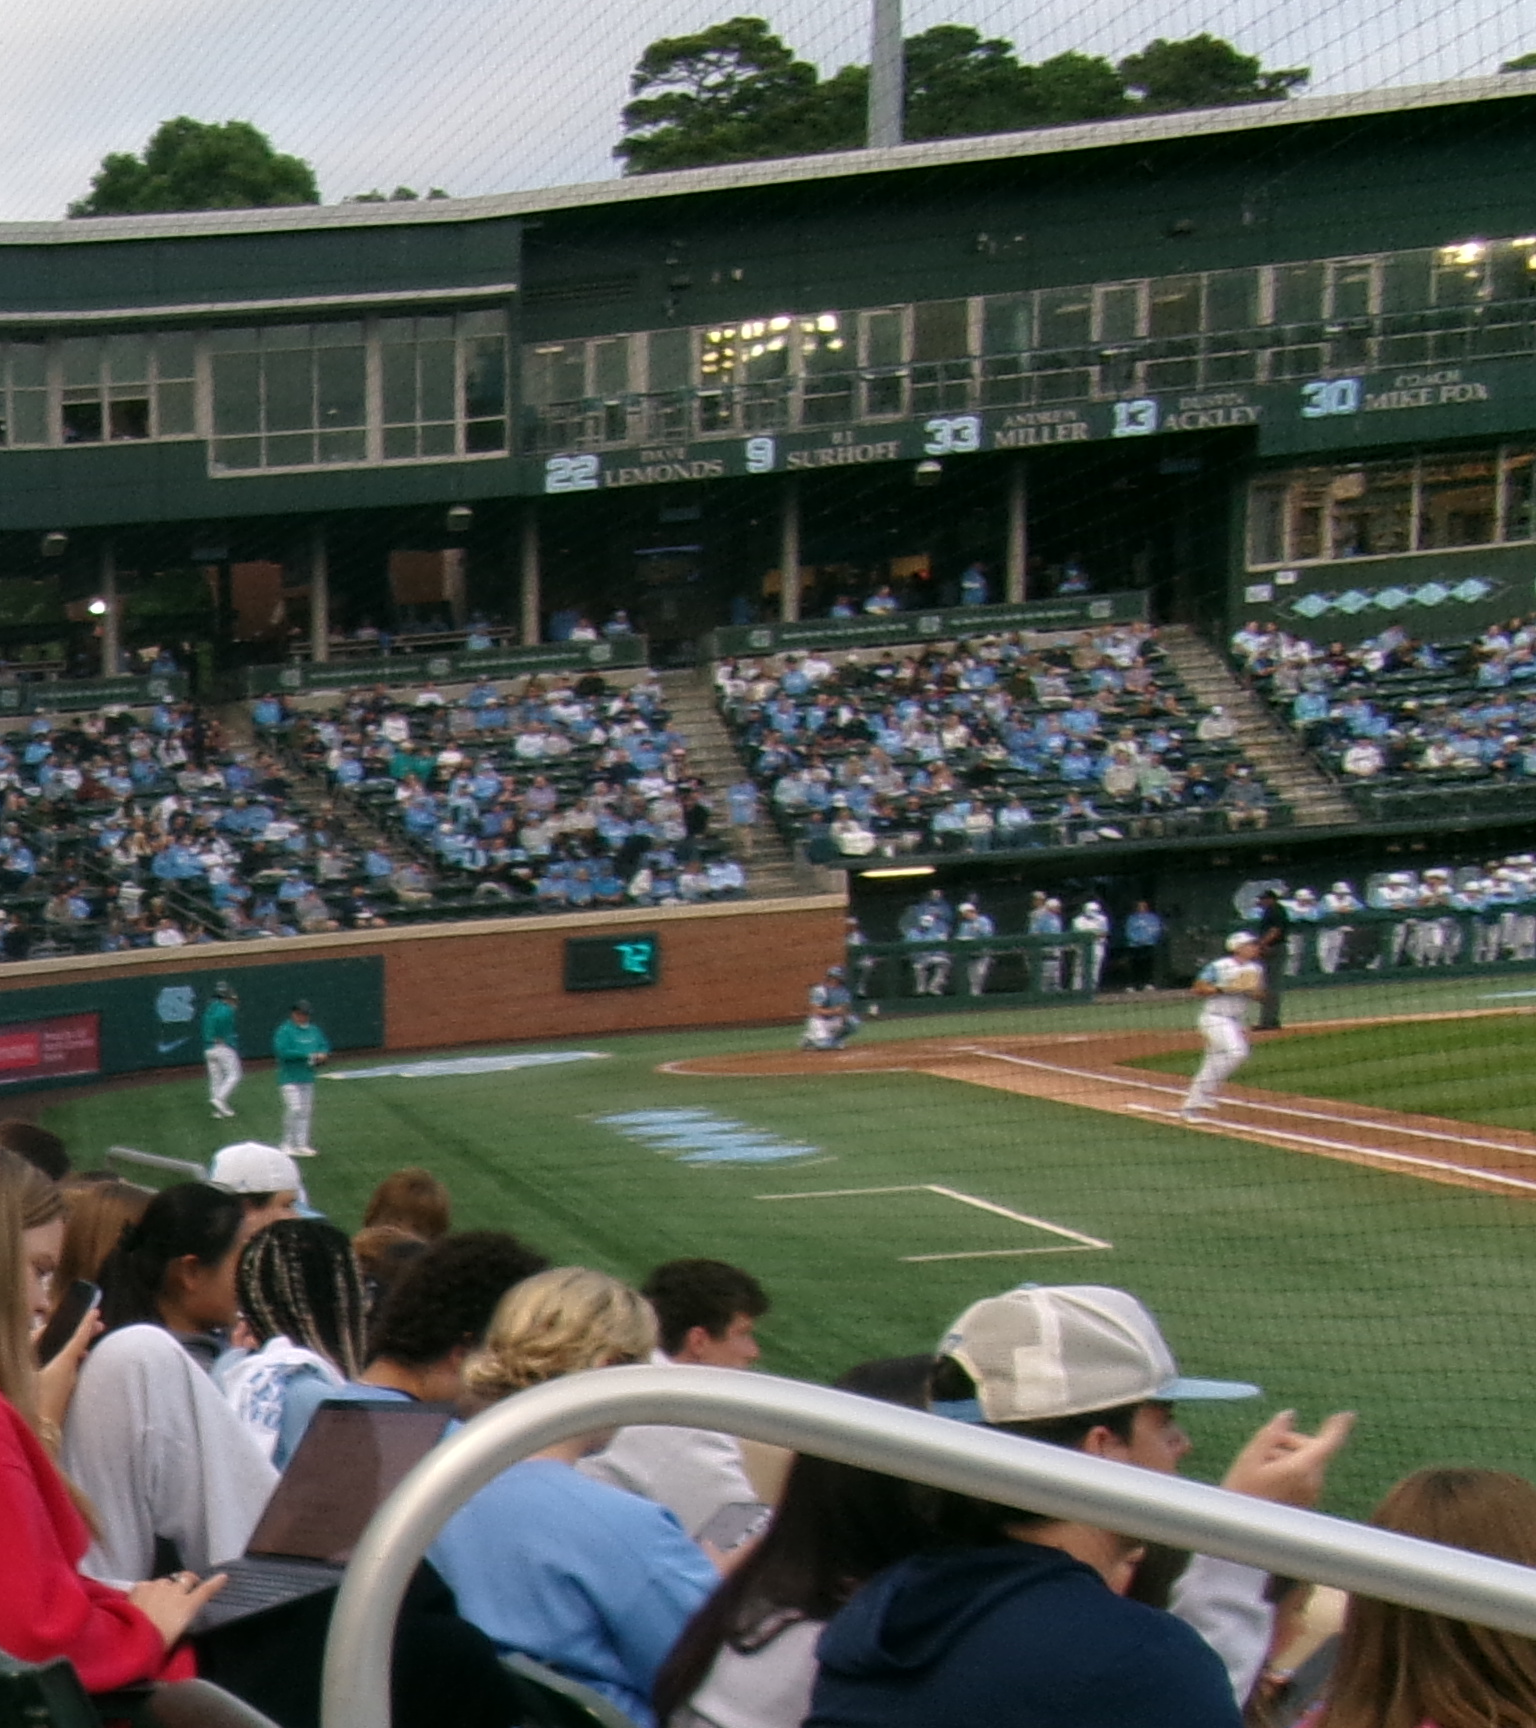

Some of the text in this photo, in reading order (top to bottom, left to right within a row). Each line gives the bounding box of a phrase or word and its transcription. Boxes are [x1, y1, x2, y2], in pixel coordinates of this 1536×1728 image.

[1300, 379, 1359, 418] 30
[1364, 382, 1492, 411] MIKE FOX
[1111, 400, 1158, 436] 13
[1164, 405, 1260, 431] ACKLEY
[924, 415, 981, 456] 33
[995, 422, 1088, 449] MILLER
[746, 437, 775, 473] 9
[787, 441, 902, 470] SURHOFF
[545, 454, 600, 494] 22
[605, 459, 724, 489] LEMONDS
